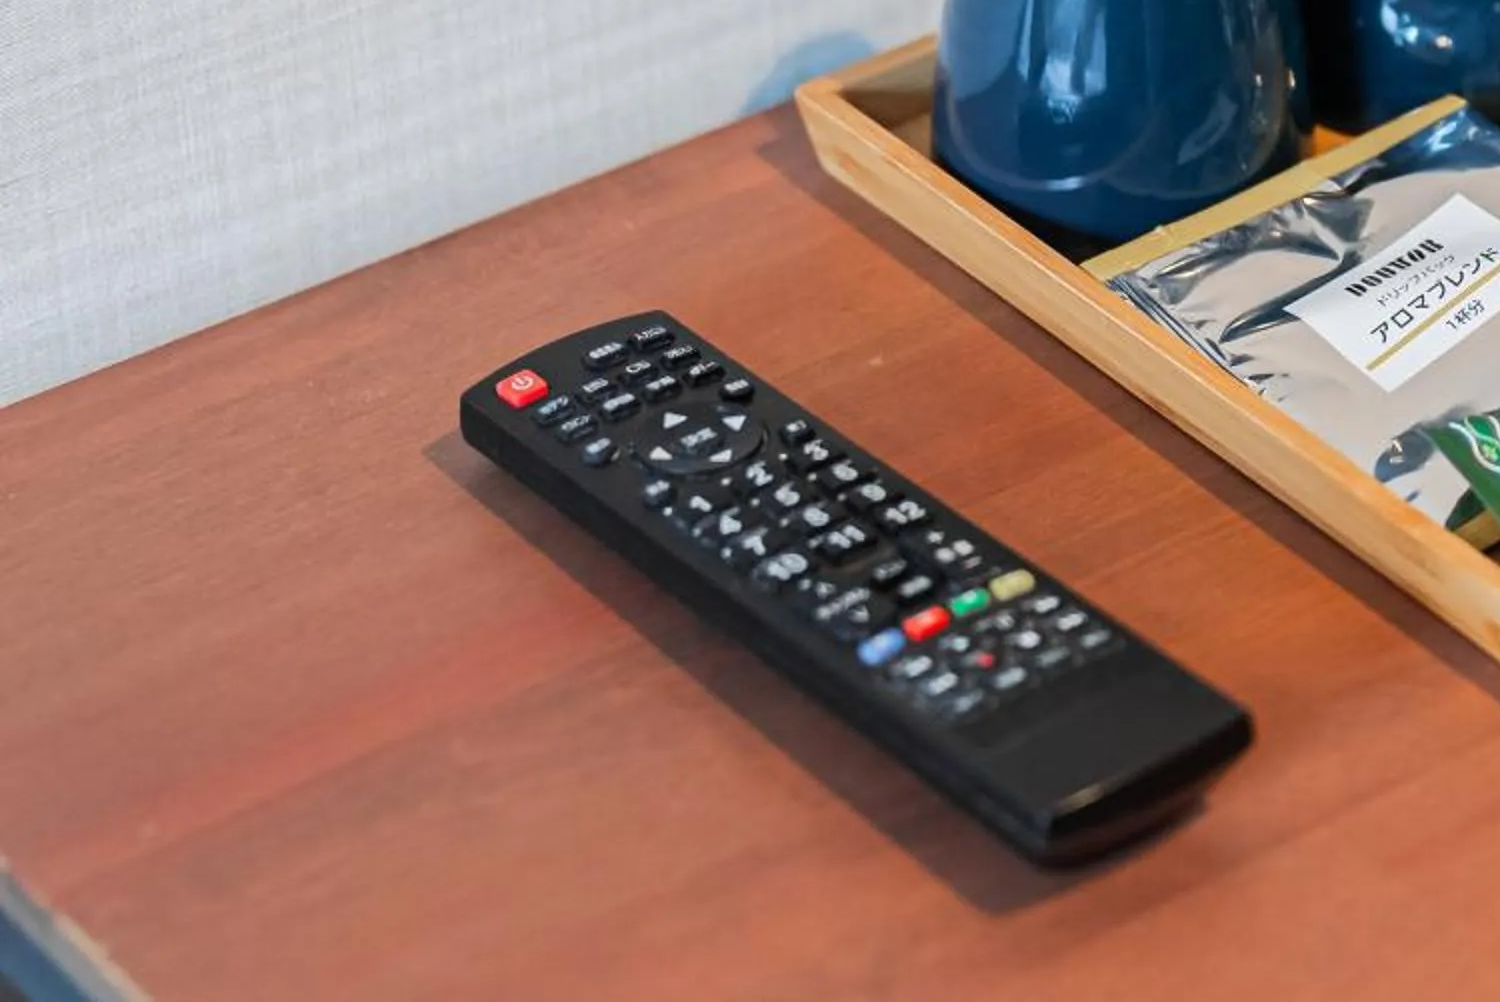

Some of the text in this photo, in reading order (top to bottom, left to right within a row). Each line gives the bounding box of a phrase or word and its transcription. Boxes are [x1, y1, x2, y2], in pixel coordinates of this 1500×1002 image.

[1344, 239, 1444, 297] DOUTOR
[1370, 247, 1499, 343] アロマブレンド
[1445, 299, 1485, 330] 1杯分
[884, 501, 926, 525] 12
